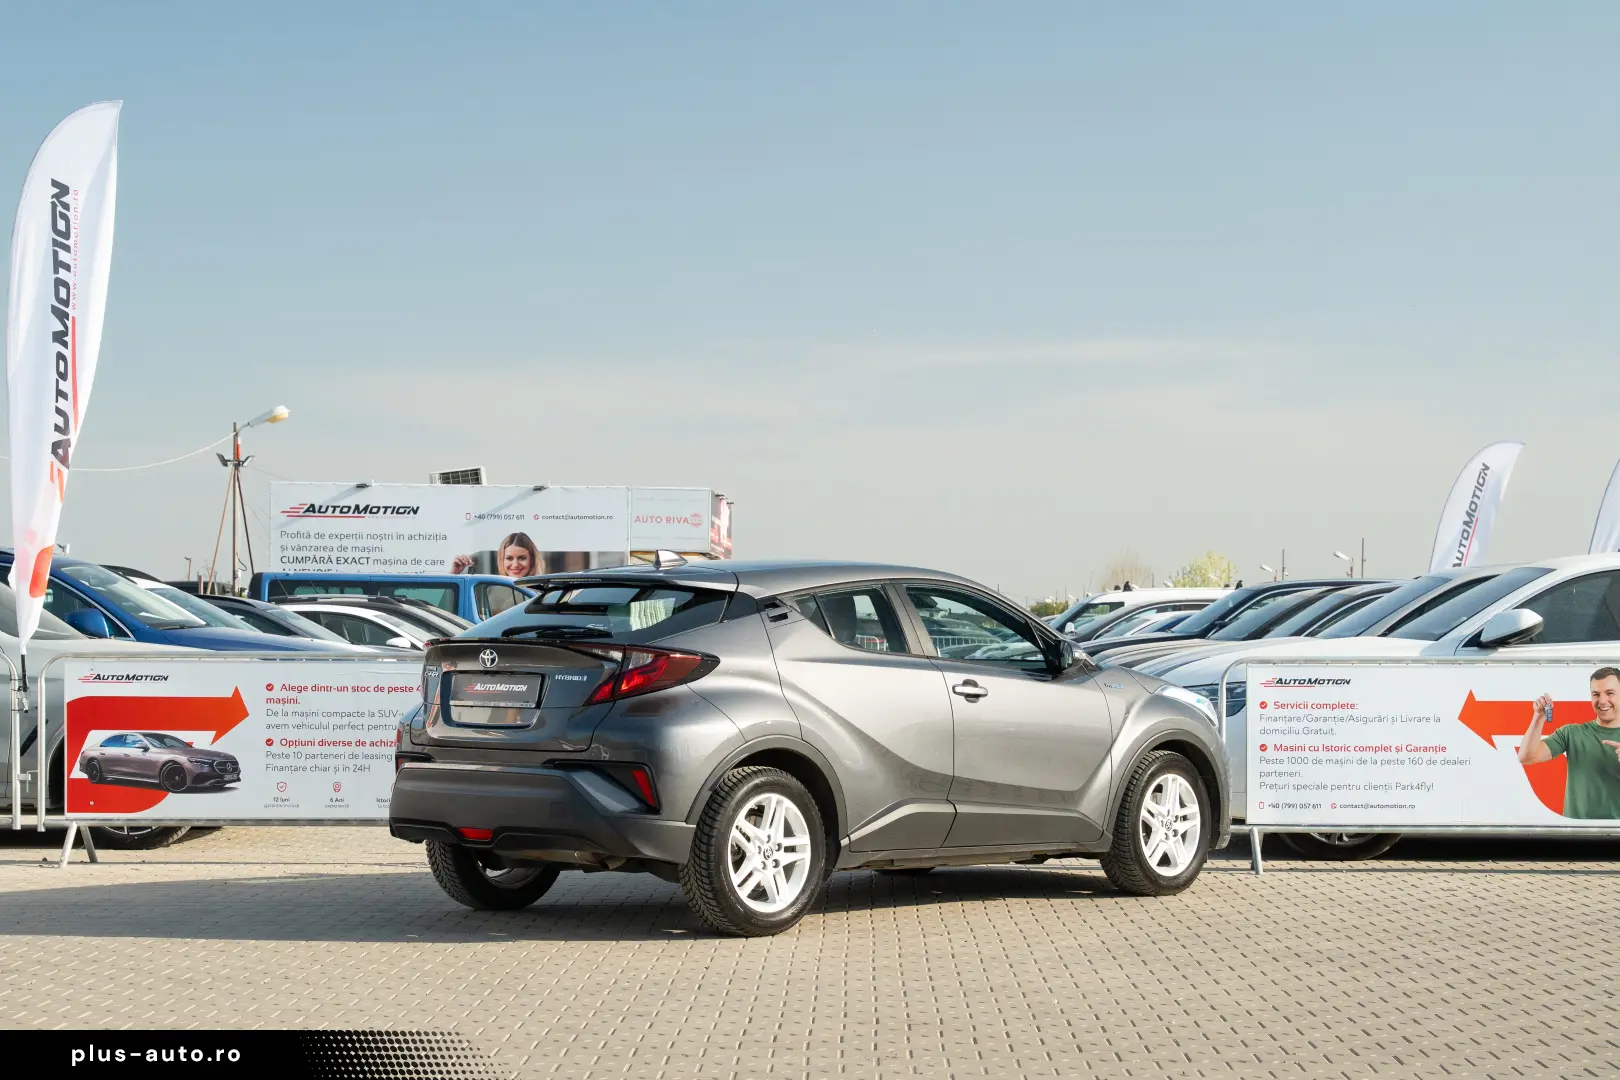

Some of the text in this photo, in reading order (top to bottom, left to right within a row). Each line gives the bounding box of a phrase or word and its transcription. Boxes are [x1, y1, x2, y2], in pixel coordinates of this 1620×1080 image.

[634, 515, 690, 525] AUTO RIVA
[281, 531, 311, 539] Profită
[329, 532, 363, 541] experții
[396, 532, 404, 540] în
[408, 533, 447, 542] achiziția
[280, 544, 384, 554] și vânzarea de mașini.
[281, 555, 333, 564] CUMPĂRĂ
[336, 557, 370, 565] EXACT
[373, 557, 407, 566] mașina
[280, 684, 308, 693] Alege
[311, 684, 348, 692] dintr-un
[388, 686, 413, 694] peste
[266, 696, 300, 706] mașini.
[1274, 701, 1357, 711] Servicii complete:
[267, 709, 279, 717] De
[292, 710, 318, 719] mașini
[322, 711, 365, 719] compacte
[1391, 715, 1397, 724] și
[292, 721, 329, 729] vehiculul
[333, 722, 364, 732] perfect
[368, 724, 398, 733] pentru
[1260, 727, 1336, 735] domiciliu Gratuit.
[280, 738, 315, 748] Opțiuni
[355, 739, 366, 747] de
[1323, 744, 1351, 752] Istoric
[1354, 744, 1392, 754] complet
[1395, 744, 1402, 754] și
[1406, 744, 1446, 754] Garanție
[266, 751, 290, 759] Peste
[293, 751, 302, 759] 10
[305, 752, 345, 760] parteneri
[362, 752, 392, 762] leasing
[1260, 756, 1284, 764] Peste
[1326, 757, 1353, 767] mașini
[1356, 757, 1367, 765] de
[1371, 757, 1377, 765] la
[1381, 758, 1405, 767] peste
[1408, 757, 1423, 765] 160
[1426, 757, 1437, 765] de
[1440, 757, 1470, 765] dealeri
[266, 764, 370, 774] Finanțare chiar și în 24H
[1260, 770, 1302, 779] parteneri.
[1260, 782, 1433, 792] Prețuri speciale pentru clienții Park4fly!
